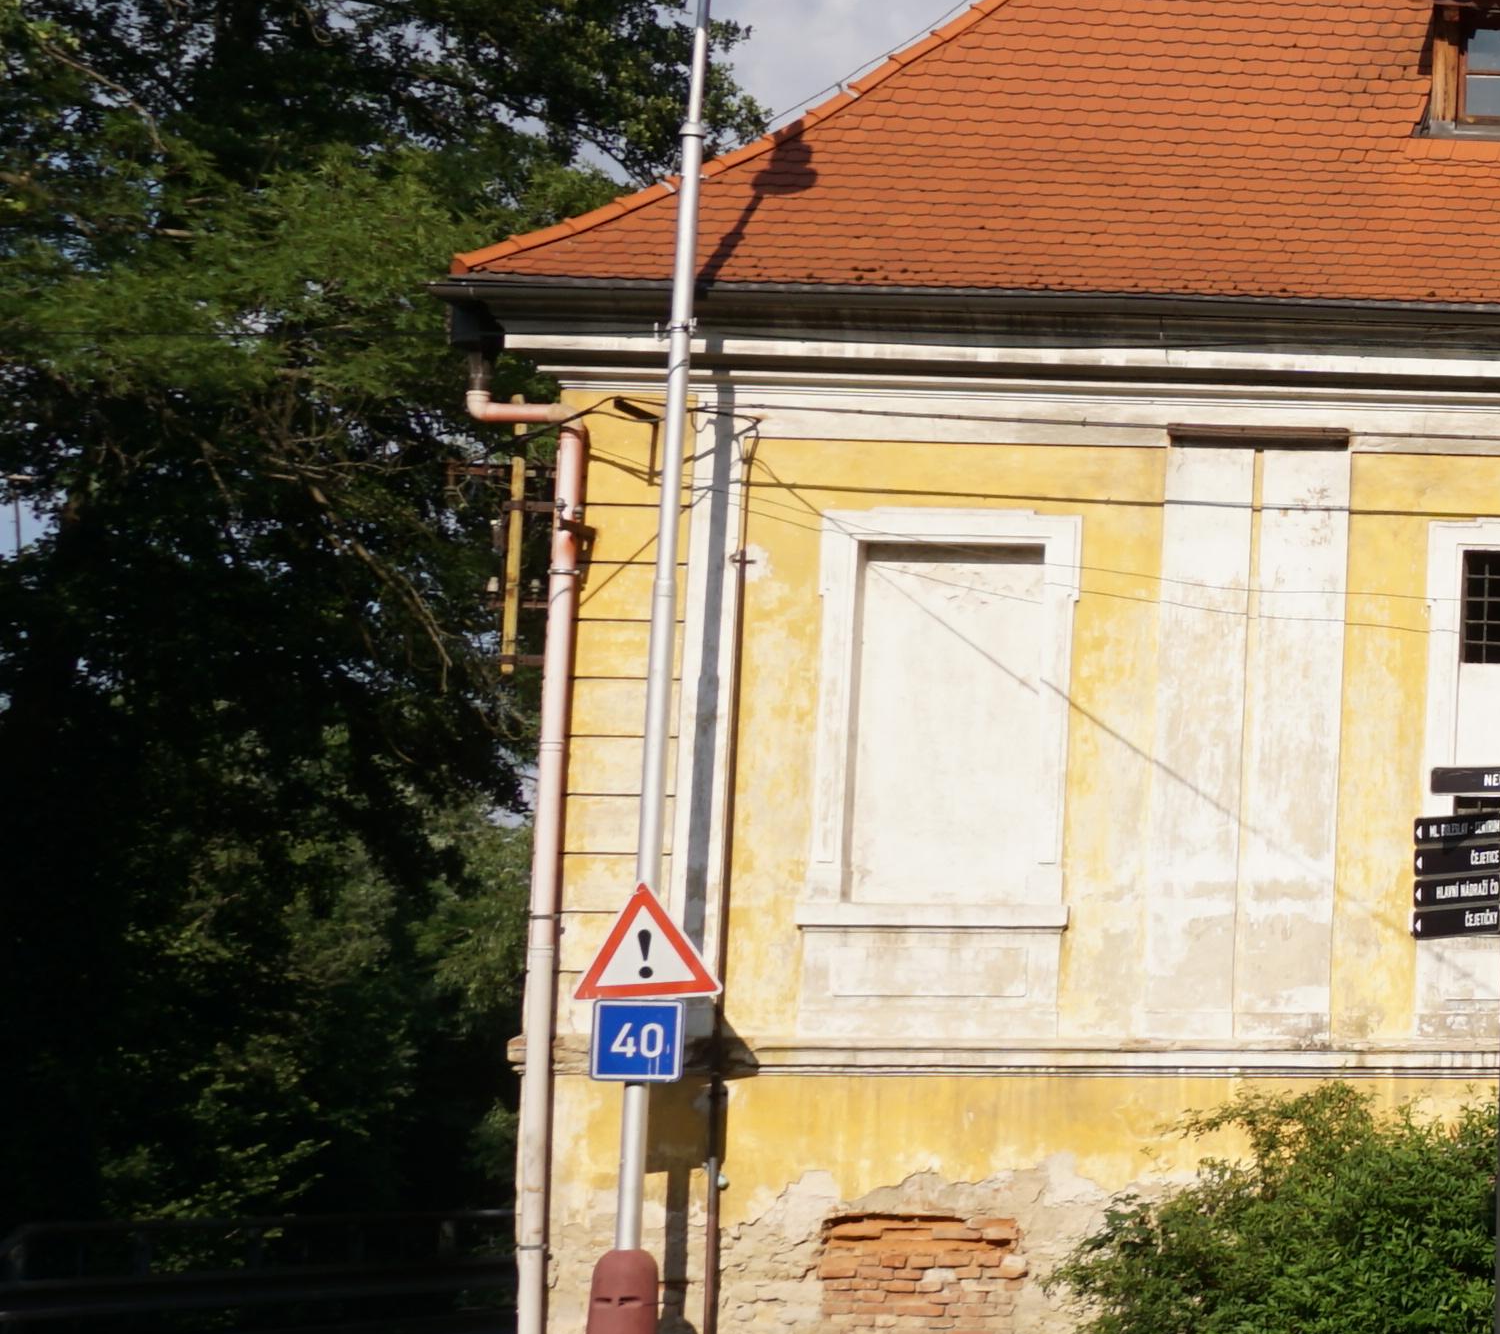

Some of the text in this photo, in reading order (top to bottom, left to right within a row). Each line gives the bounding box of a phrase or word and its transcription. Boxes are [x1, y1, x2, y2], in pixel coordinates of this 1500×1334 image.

[1470, 849, 1499, 865] ČEJETICE
[1436, 881, 1459, 899] HLAVNÍ
[610, 1022, 664, 1058] 40
